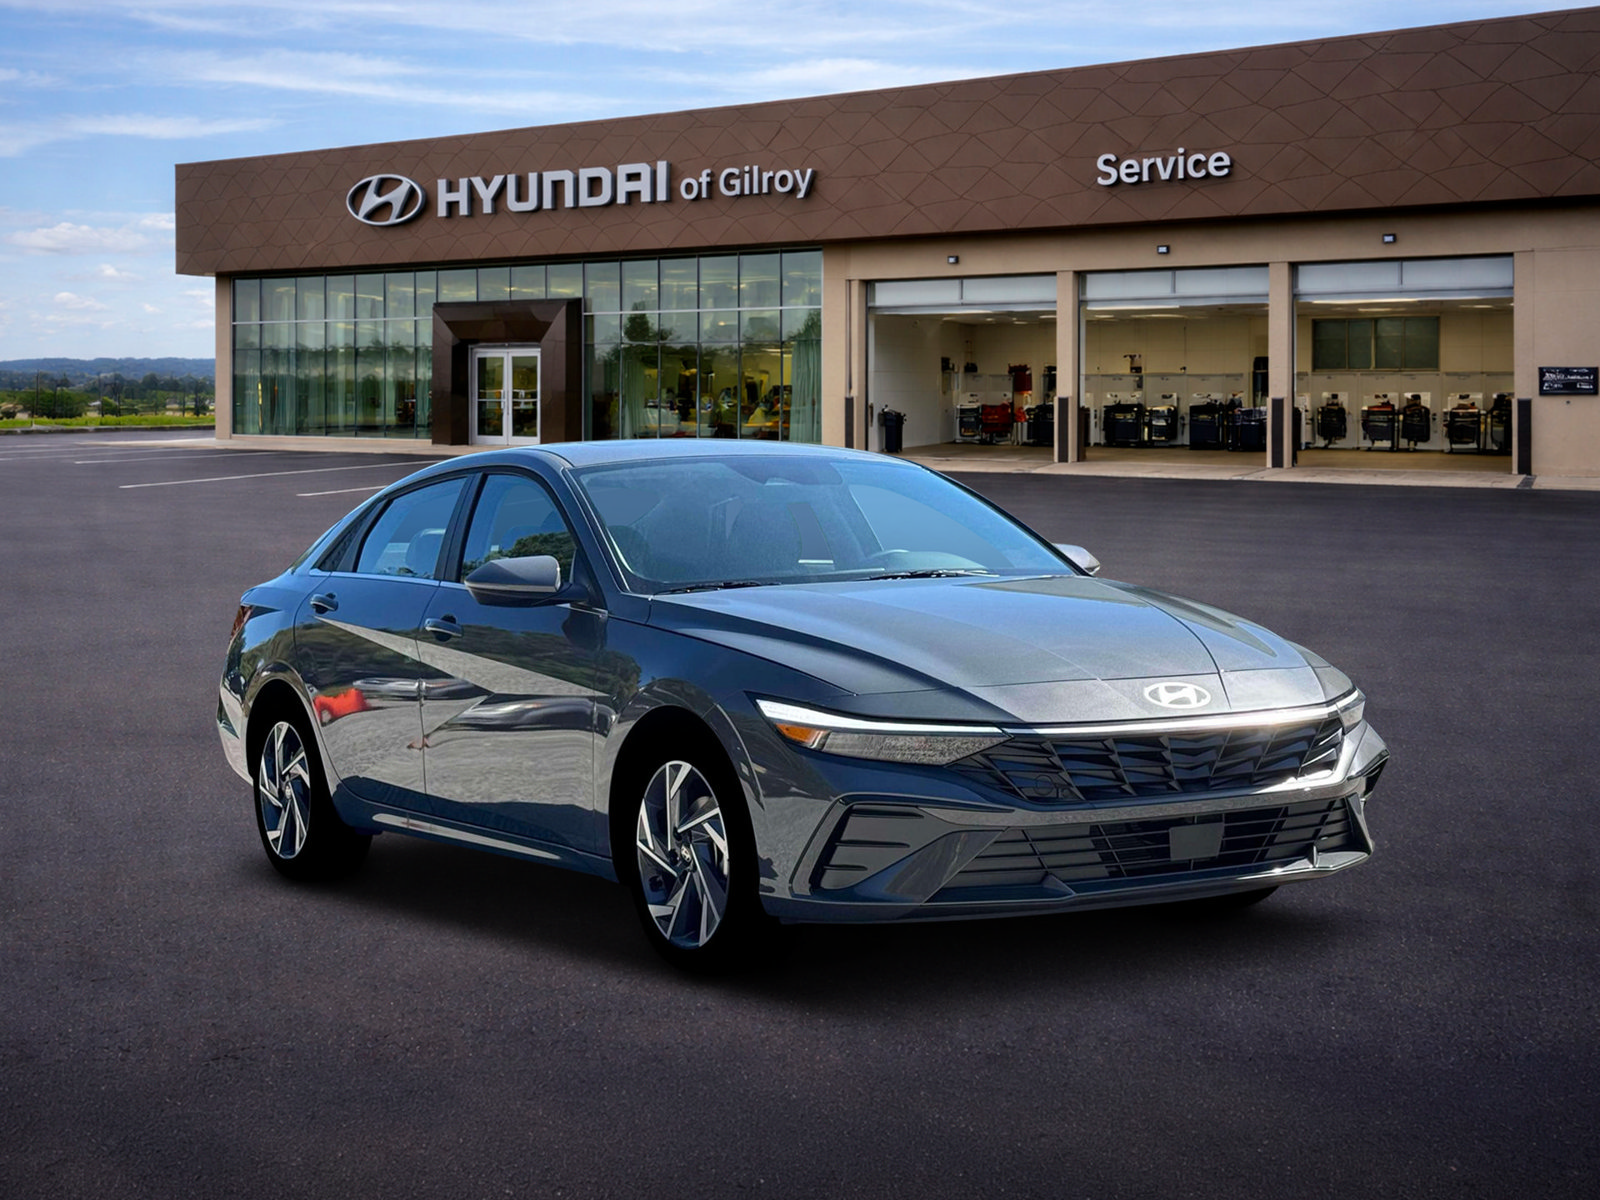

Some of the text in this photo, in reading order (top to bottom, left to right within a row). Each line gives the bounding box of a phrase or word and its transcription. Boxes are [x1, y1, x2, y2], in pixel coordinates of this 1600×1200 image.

[436, 160, 814, 218] HYUNDAI of Gilroy
[1096, 147, 1233, 186] Service
